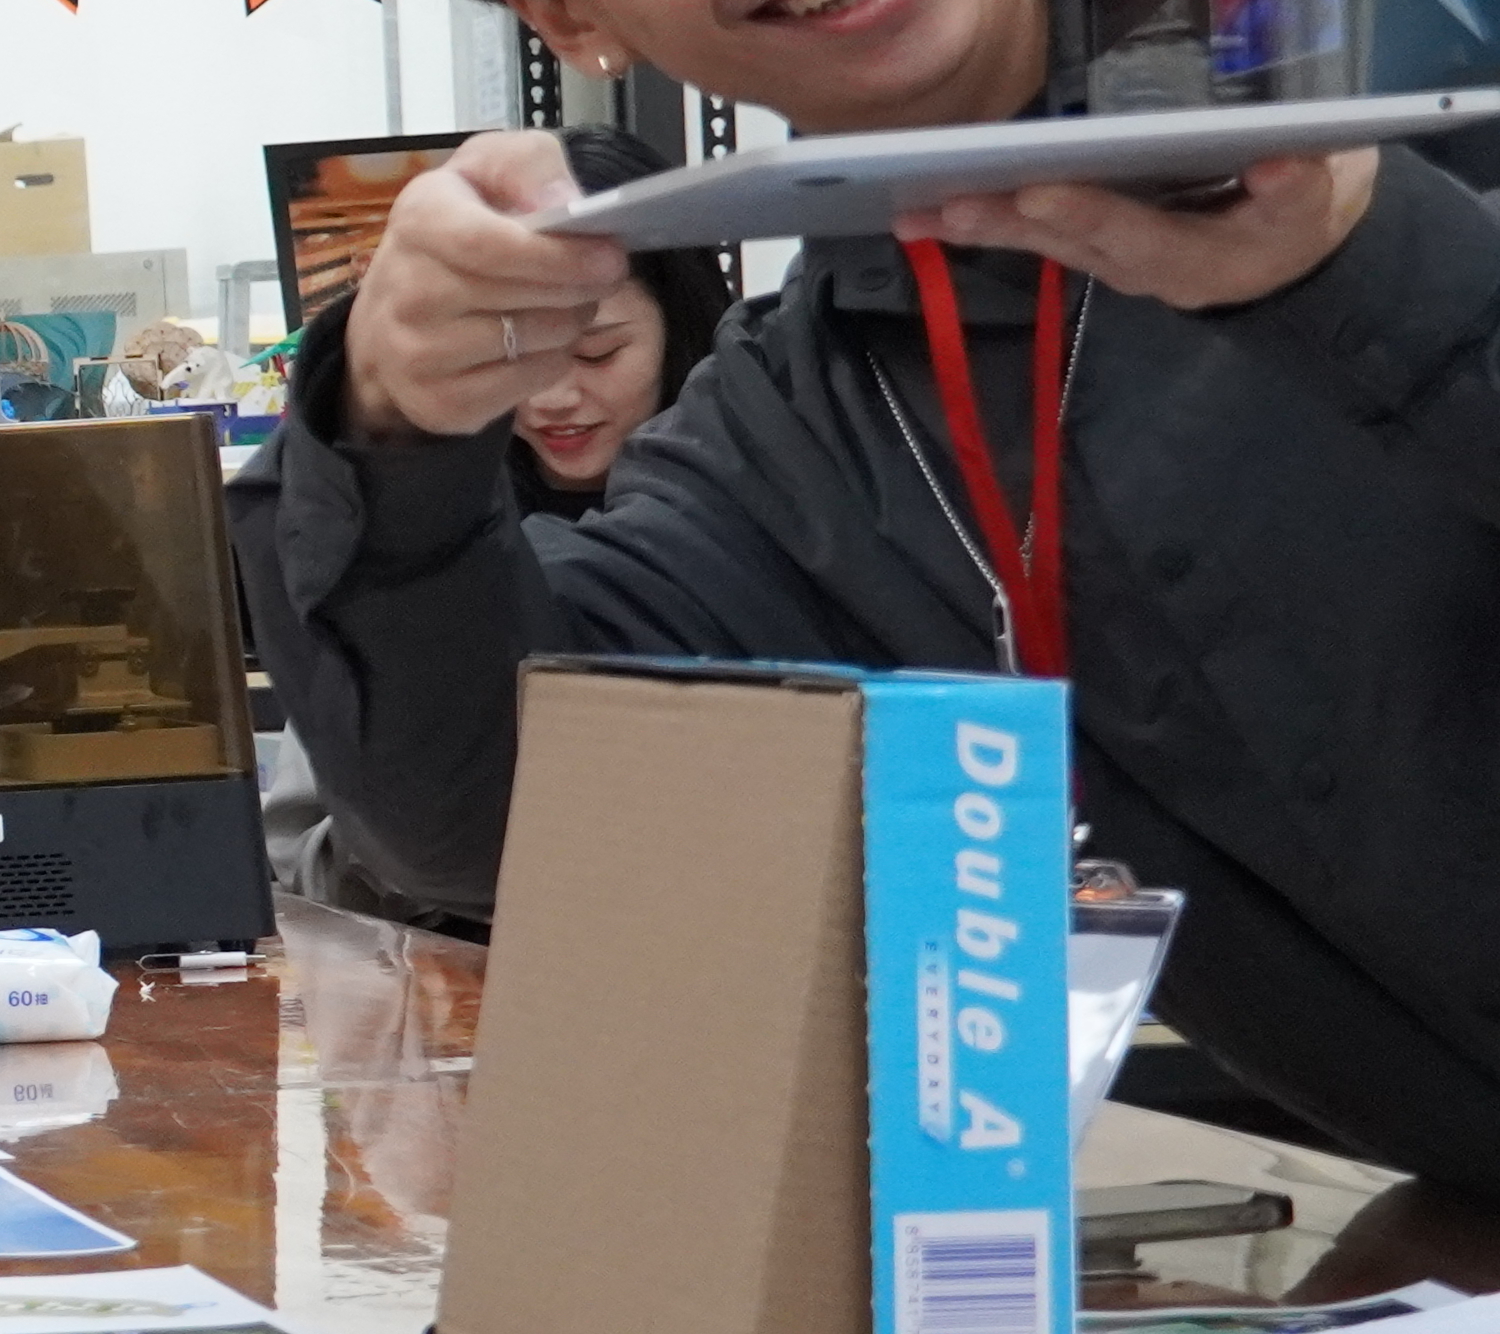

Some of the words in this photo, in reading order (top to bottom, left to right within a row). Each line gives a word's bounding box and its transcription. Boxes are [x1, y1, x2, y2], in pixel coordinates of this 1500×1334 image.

[953, 721, 1020, 1054] Double
[923, 940, 940, 1115] EVERYDAY
[958, 1088, 1022, 1151] A
